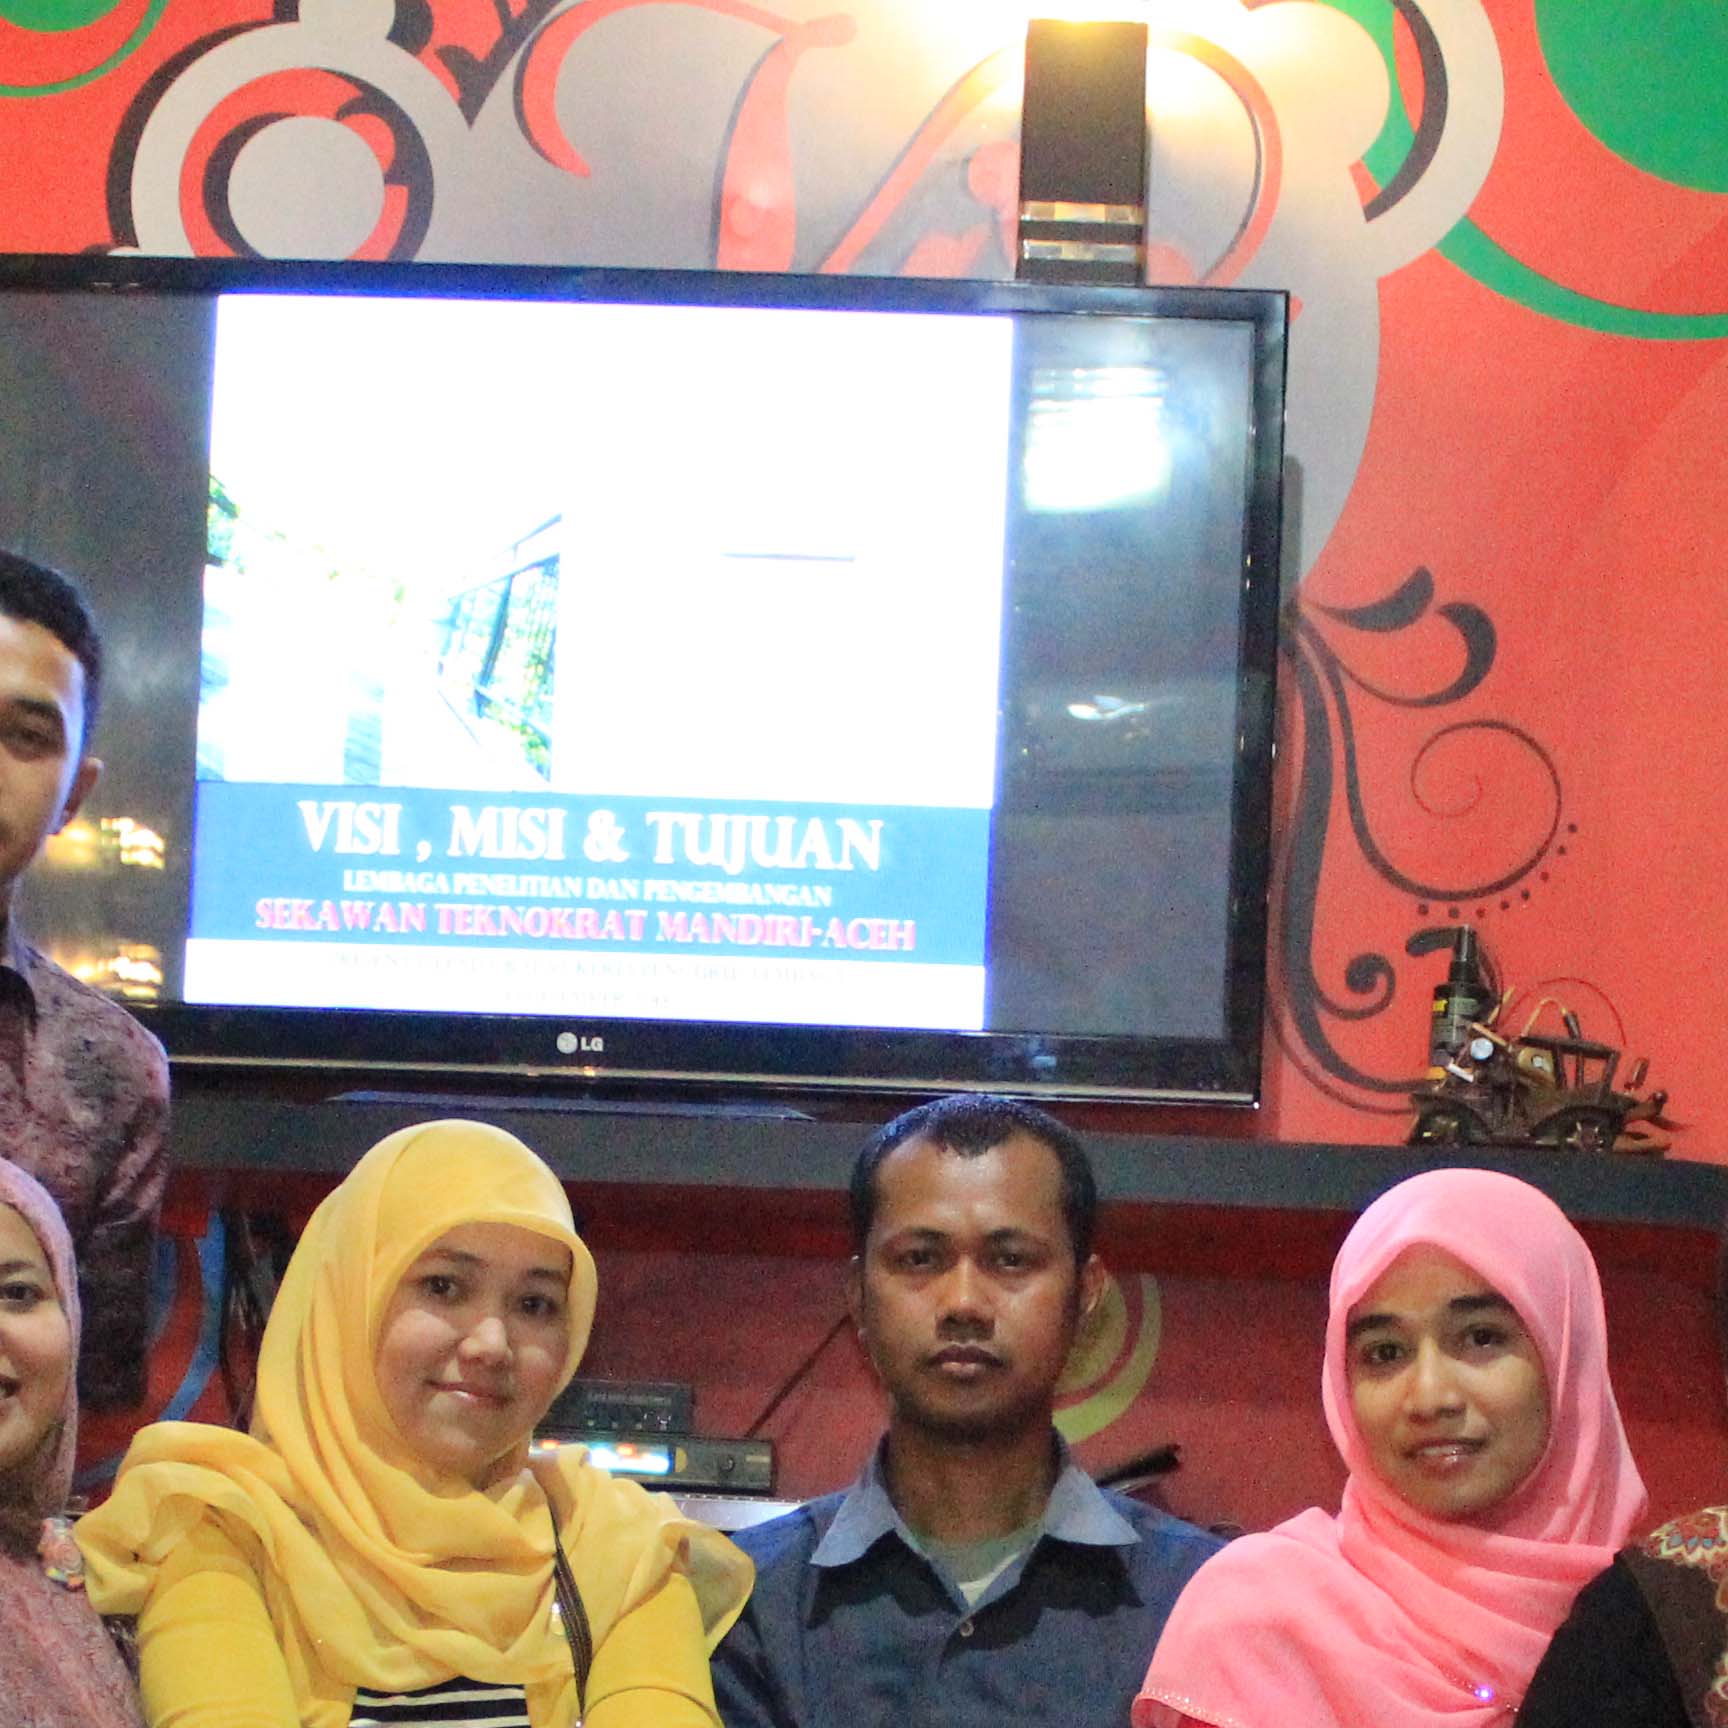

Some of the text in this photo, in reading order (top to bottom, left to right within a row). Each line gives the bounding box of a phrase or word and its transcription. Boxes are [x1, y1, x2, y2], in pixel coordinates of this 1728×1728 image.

[297, 800, 403, 856] VISI
[446, 804, 568, 861] MISI
[582, 808, 631, 864] &
[644, 811, 885, 876] TUJUAN
[342, 868, 833, 908] LEMBAGA PENELITIAN DAN PENGEMBANGAN
[255, 897, 917, 952] SEKAWAN TEKNOKRAT MANDIRI-ACEH
[580, 1035, 604, 1053] LG
